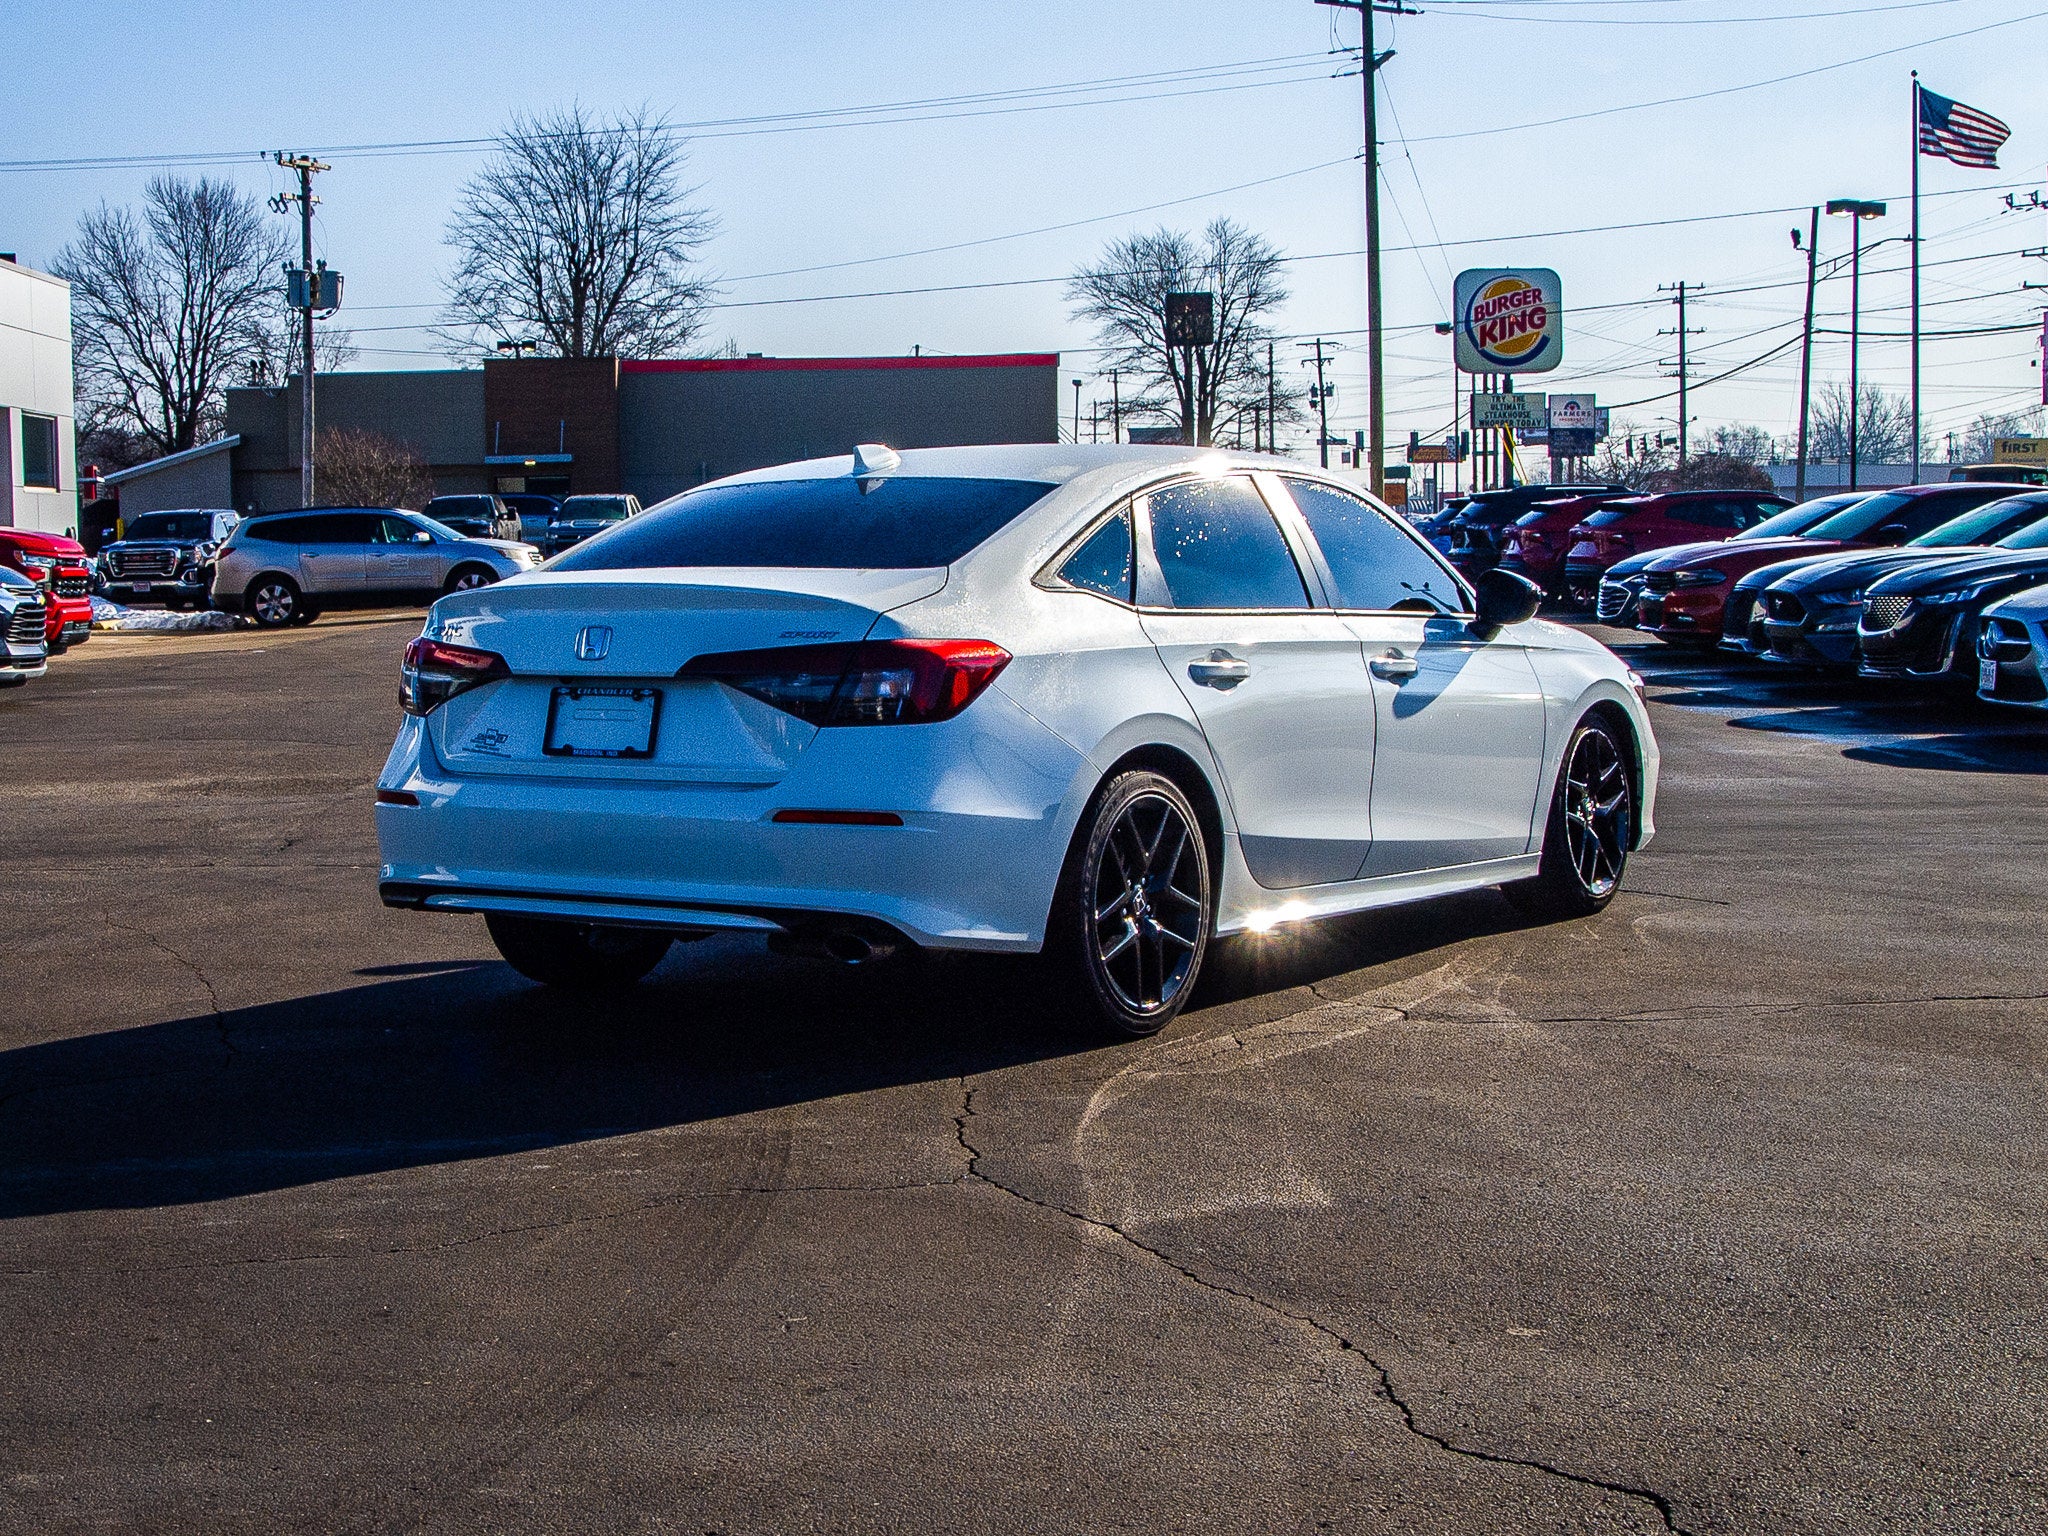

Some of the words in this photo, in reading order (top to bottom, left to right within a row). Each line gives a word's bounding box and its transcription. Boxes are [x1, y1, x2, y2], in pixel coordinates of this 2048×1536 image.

[1474, 288, 1543, 323] BURGER
[1479, 306, 1547, 349] KING
[1490, 403, 1526, 411] ULTIMATE
[1484, 411, 1532, 419] STEAKHOUSE
[1517, 419, 1542, 427] TODAY
[779, 631, 840, 639] SPORT
